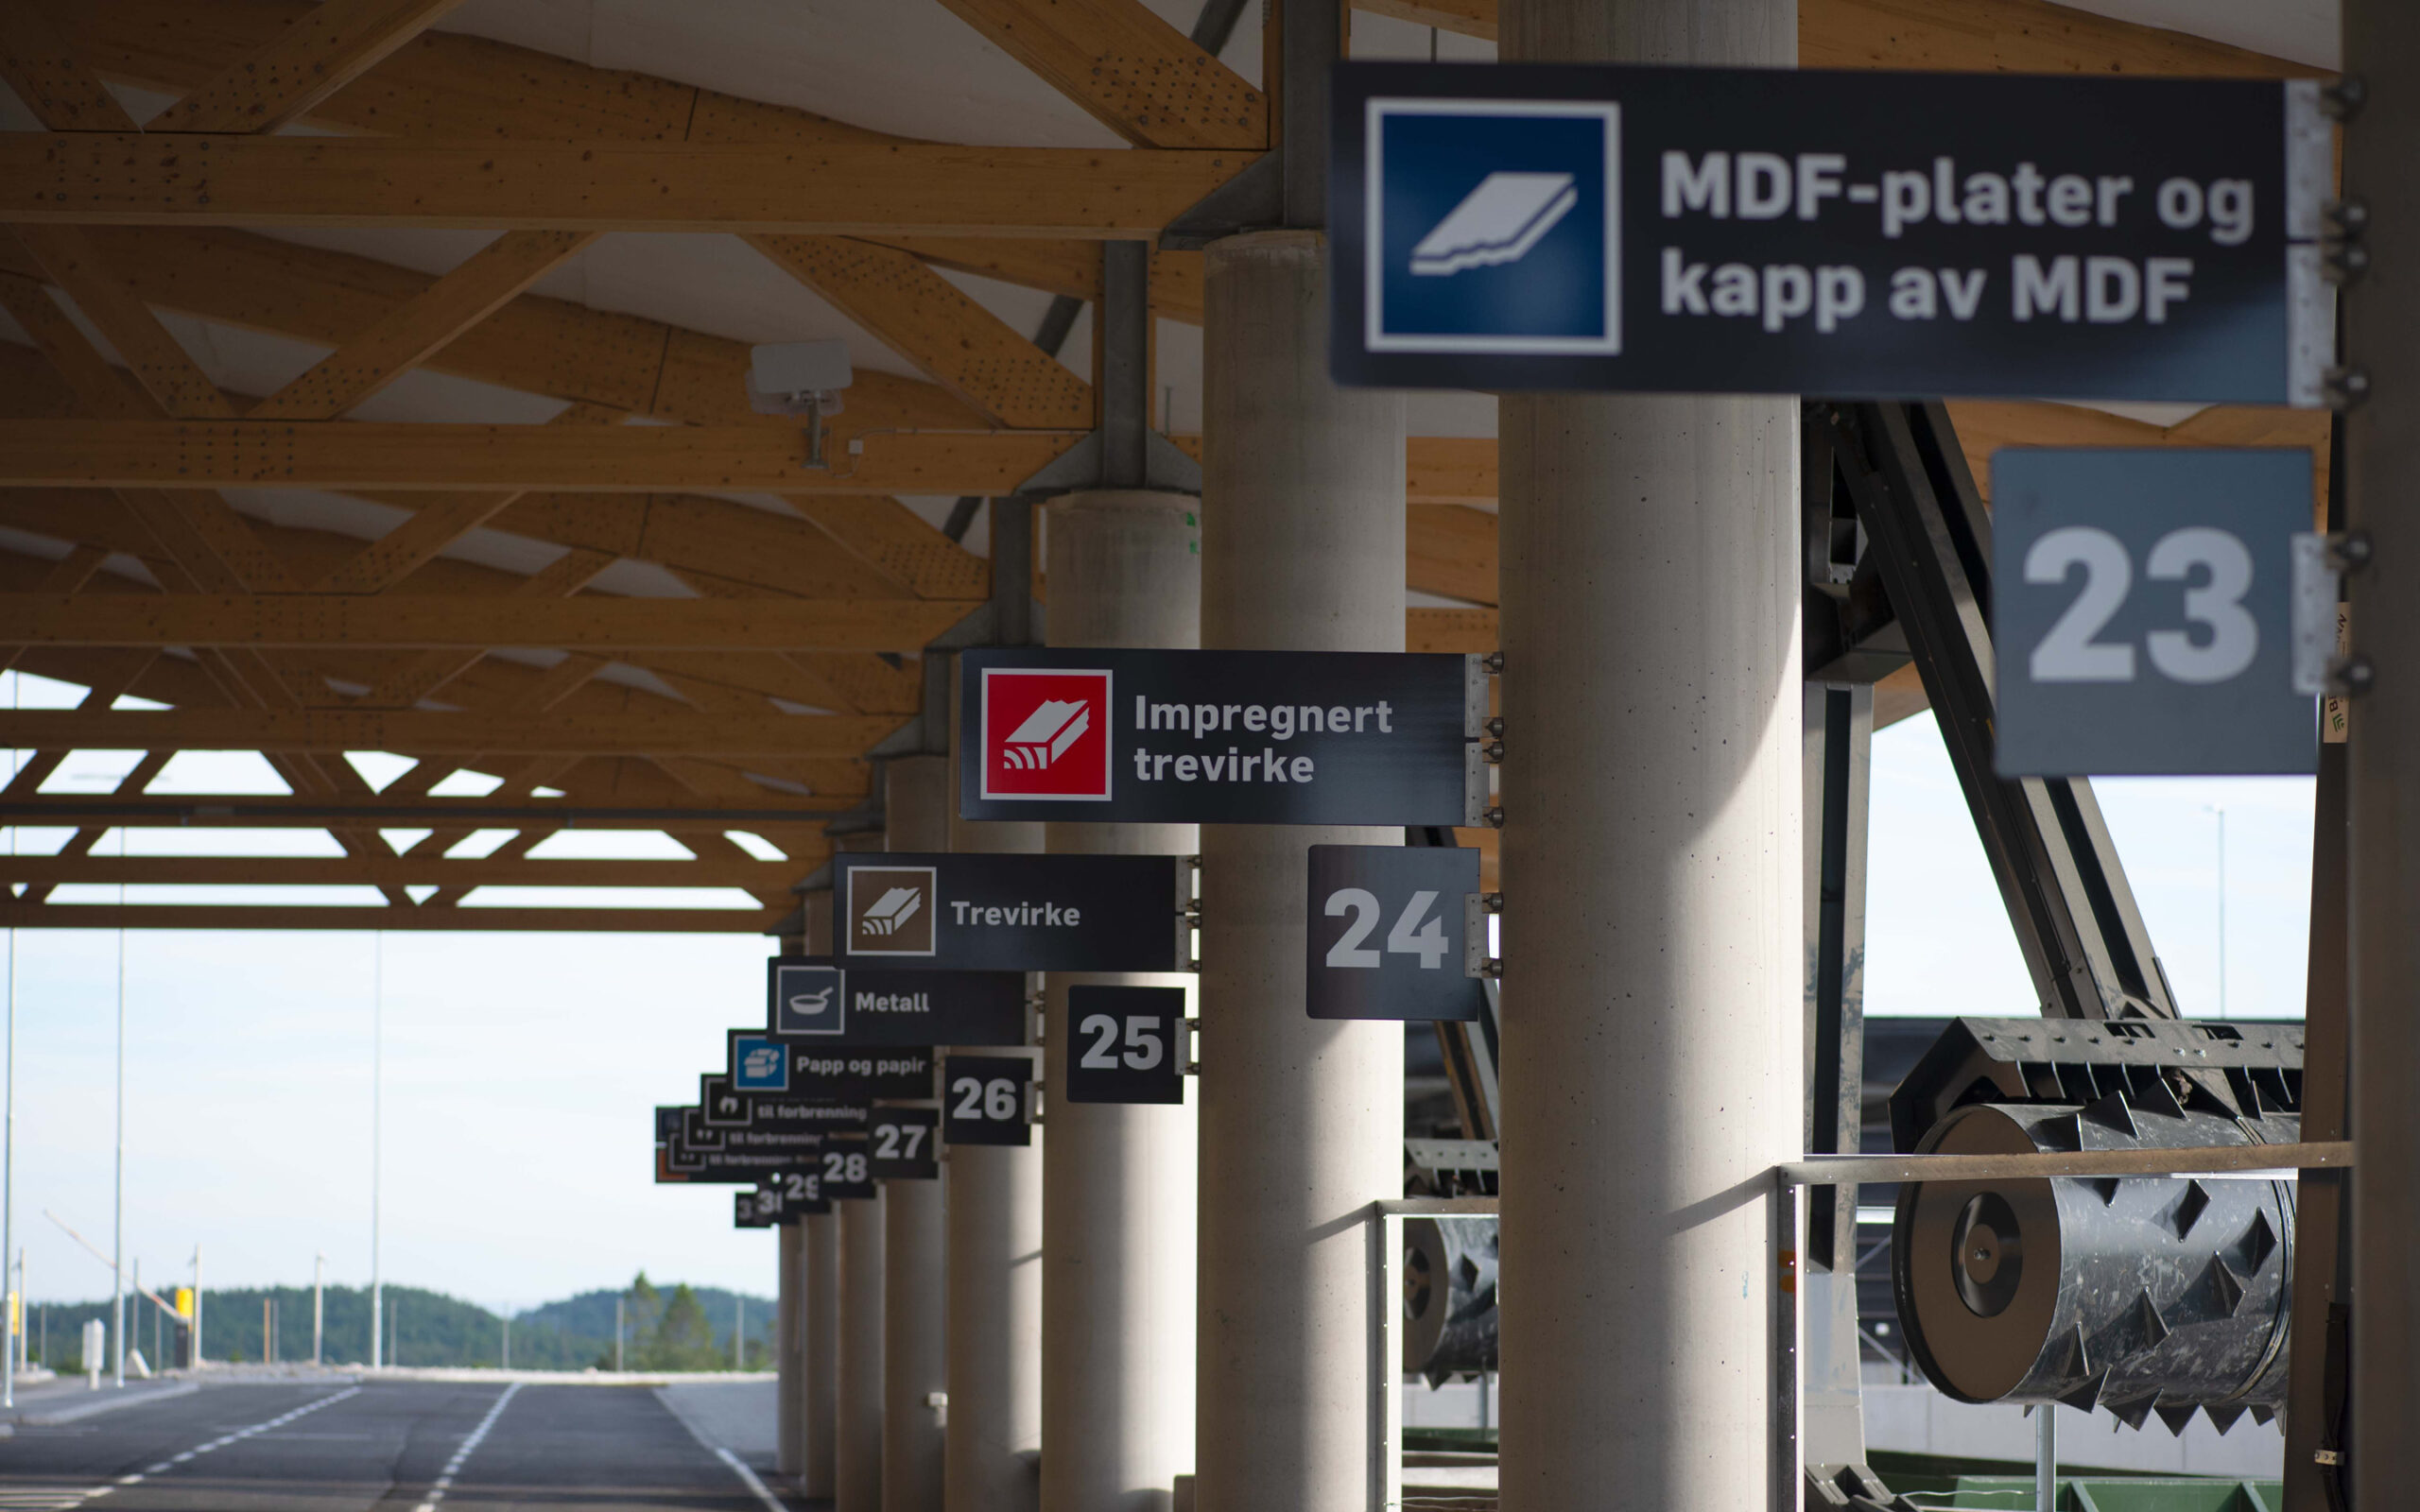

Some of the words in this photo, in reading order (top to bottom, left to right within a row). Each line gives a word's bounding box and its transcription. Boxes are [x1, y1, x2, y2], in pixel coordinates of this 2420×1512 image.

[1661, 151, 2134, 239] MDF-plater
[2156, 177, 2255, 246] og
[1661, 248, 1866, 334] kapp
[1889, 266, 1987, 319] av
[2013, 254, 2194, 324] MDF
[2023, 525, 2258, 683] 23
[1135, 695, 1393, 741] Impregnert
[1133, 747, 1315, 783] trevirke
[950, 901, 1080, 927] Trevirke
[1324, 887, 1449, 970] 24
[855, 991, 931, 1013] Metall
[1080, 1013, 1164, 1071] 25
[796, 1056, 845, 1076] Papp
[847, 1059, 873, 1076] og
[876, 1056, 925, 1076] papir
[757, 1104, 775, 1119] til
[952, 1075, 1017, 1122] 26
[729, 1132, 745, 1145] til
[873, 1123, 927, 1160] 27
[821, 1151, 869, 1184] 28
